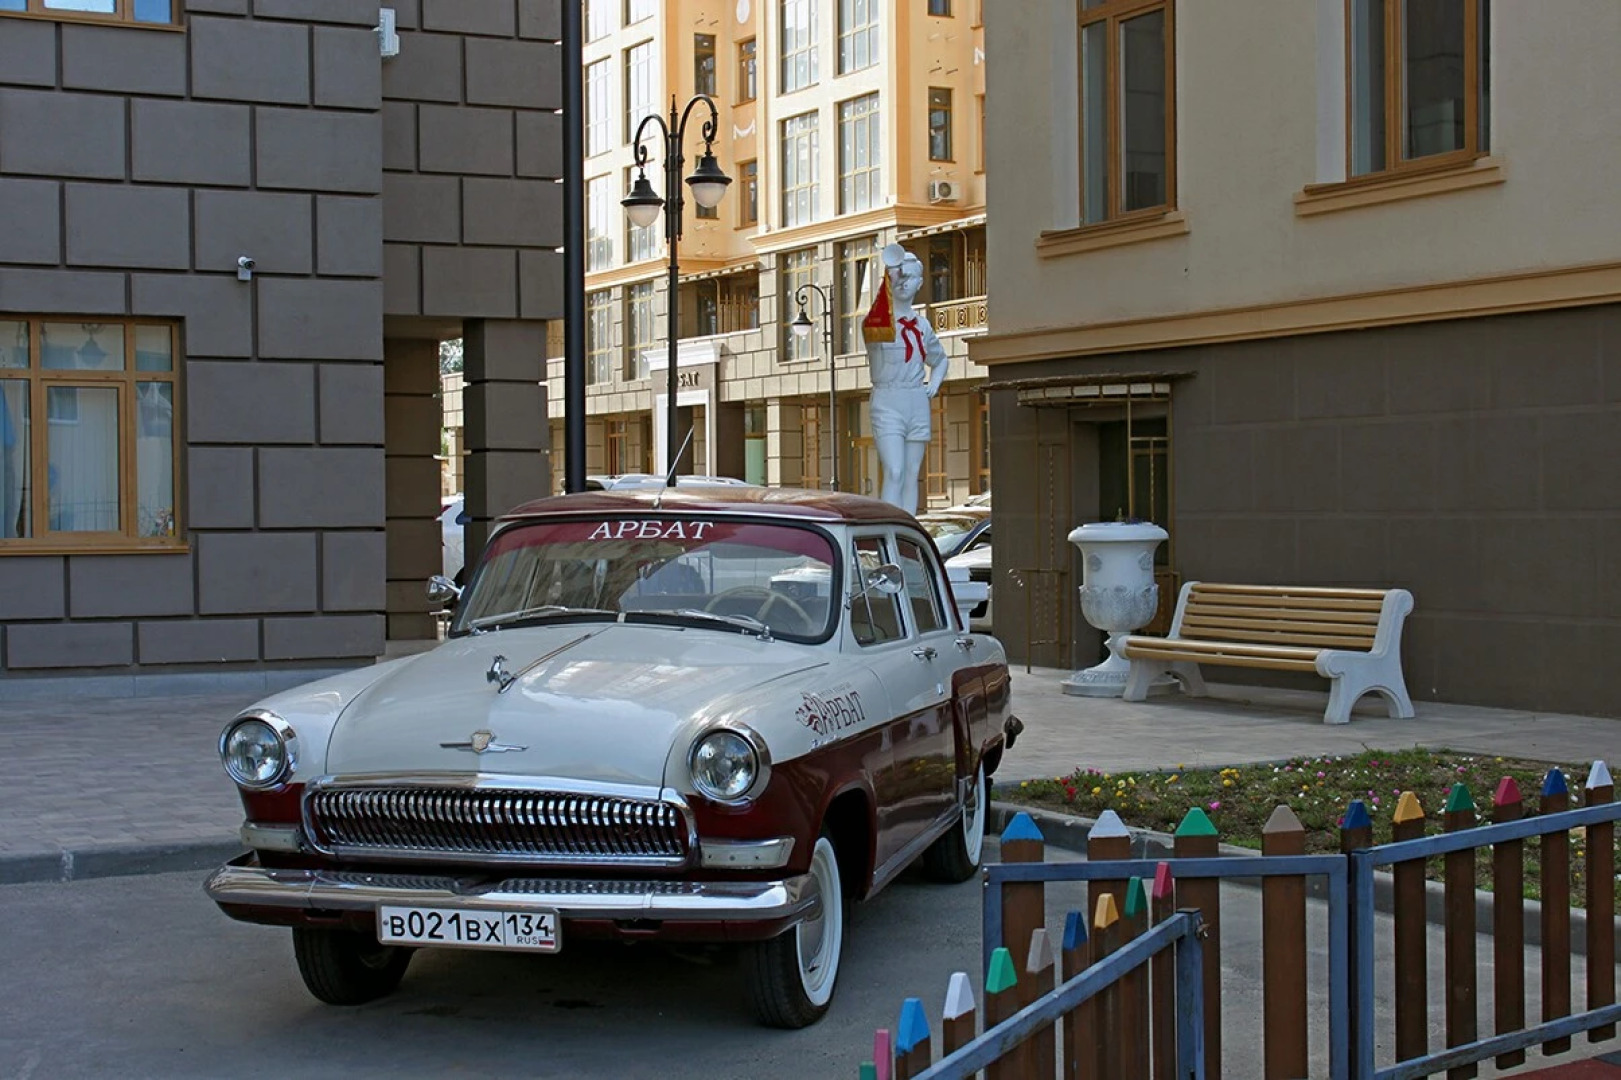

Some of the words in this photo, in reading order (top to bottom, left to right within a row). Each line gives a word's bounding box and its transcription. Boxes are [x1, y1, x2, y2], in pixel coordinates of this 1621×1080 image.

[588, 520, 714, 540] АРБАТ
[389, 910, 501, 942] В021ВХ
[506, 914, 550, 937] 134
[516, 936, 539, 945] RUS
